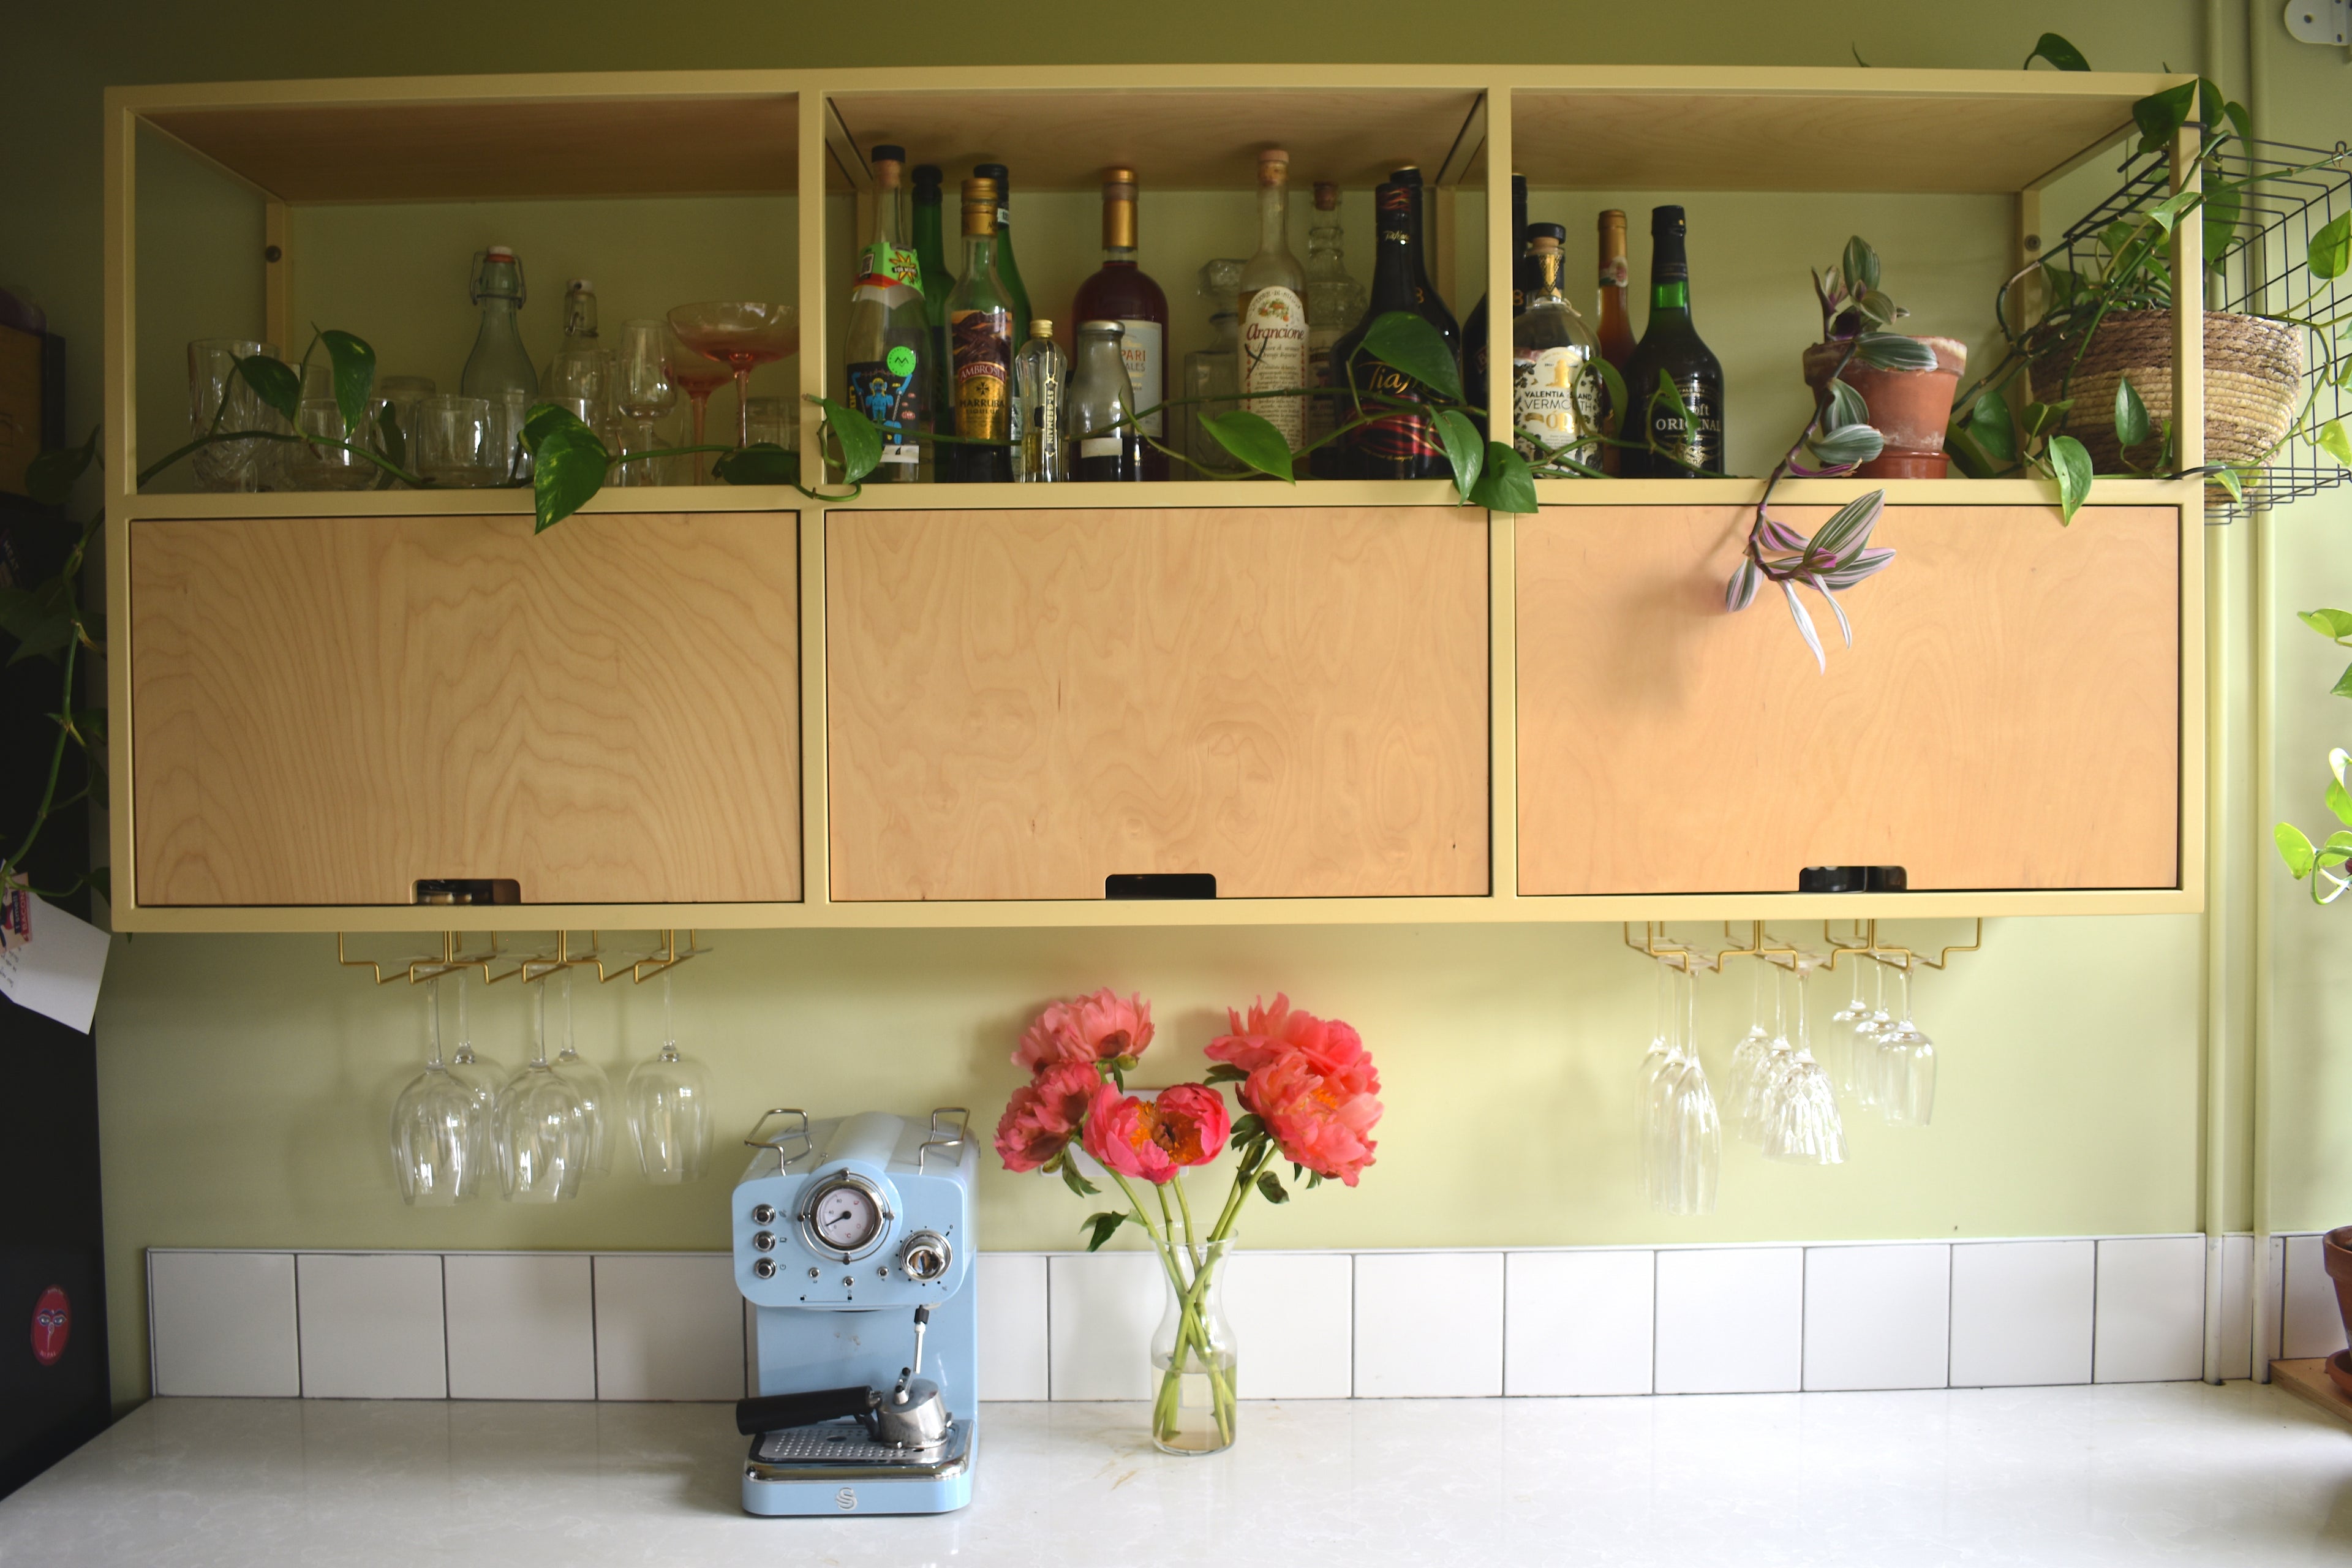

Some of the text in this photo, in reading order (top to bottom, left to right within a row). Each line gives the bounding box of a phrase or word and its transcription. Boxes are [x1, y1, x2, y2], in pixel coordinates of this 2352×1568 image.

[960, 364, 1005, 382] AMBROSIA
[1566, 392, 1593, 401] ISAND
[960, 399, 1005, 407] HARRUBA
[1656, 418, 1721, 432] ORINAL
